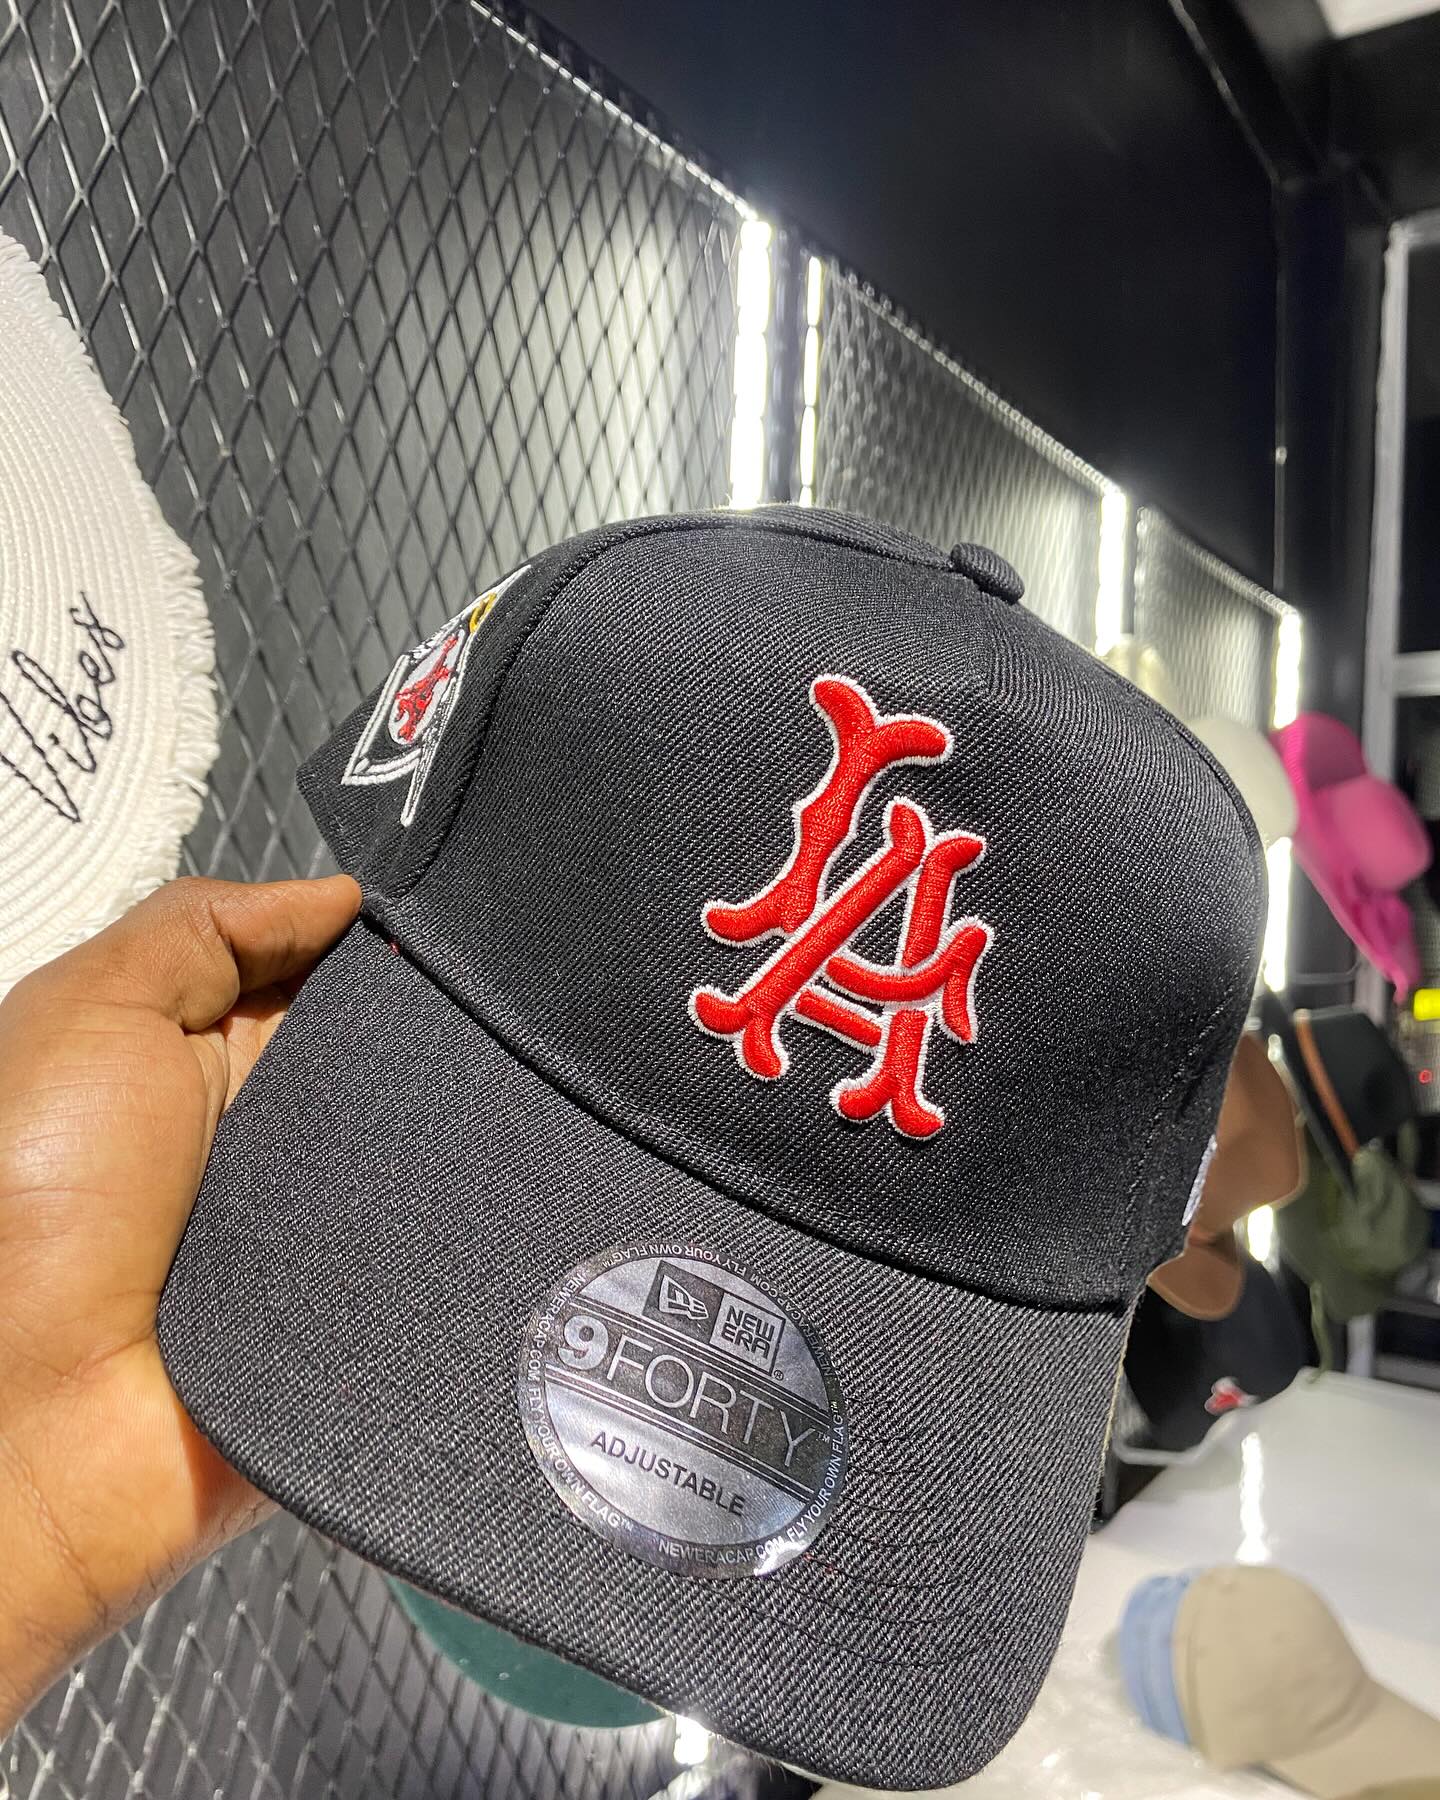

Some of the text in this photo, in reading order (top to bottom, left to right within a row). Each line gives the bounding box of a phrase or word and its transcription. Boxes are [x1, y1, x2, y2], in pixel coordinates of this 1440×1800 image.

[648, 1244, 682, 1256] OWN
[685, 1246, 723, 1265] YOUR
[722, 1261, 747, 1276] FLY
[721, 1323, 771, 1360] ERA
[727, 1305, 775, 1342] NEW
[528, 1388, 545, 1413] FLY
[534, 1413, 561, 1459] YOUR
[554, 1458, 586, 1493] OWN
[591, 1431, 746, 1516] ADJUSTABLE
[786, 1518, 809, 1542] FLY
[804, 1488, 832, 1524] YOUR
[824, 1455, 842, 1489] OWN
